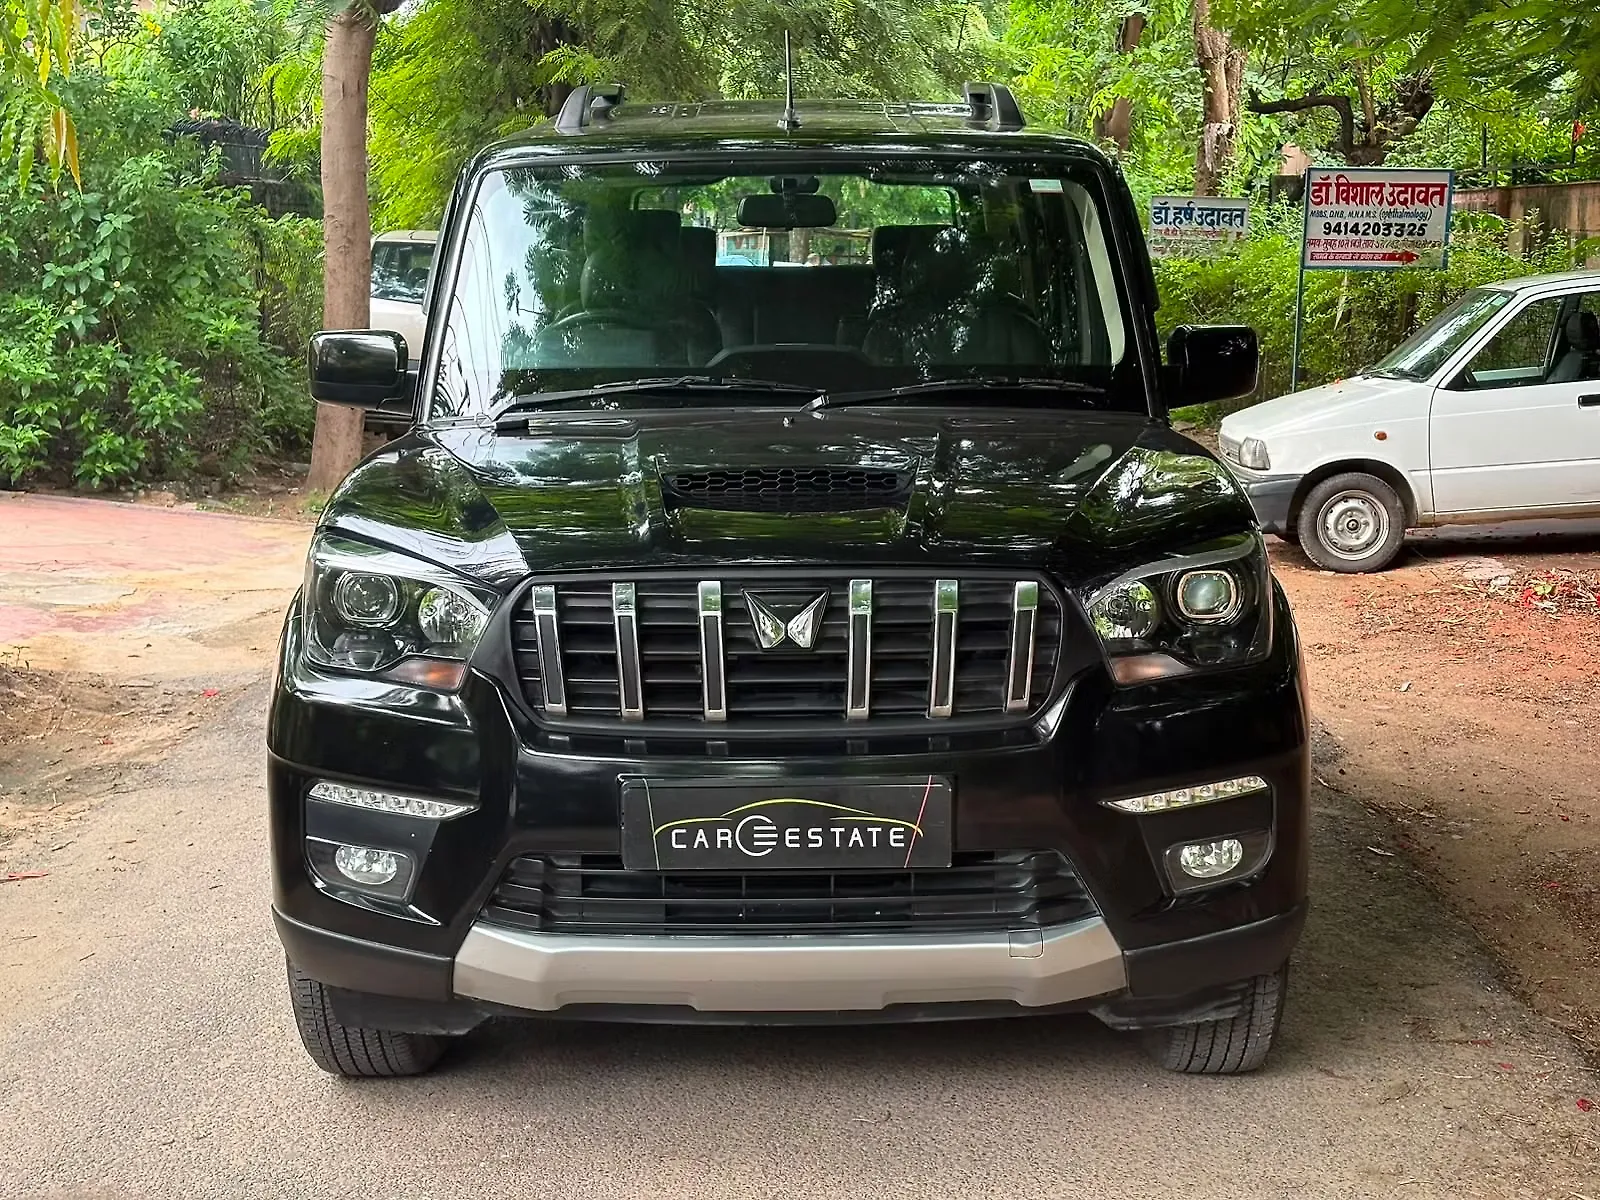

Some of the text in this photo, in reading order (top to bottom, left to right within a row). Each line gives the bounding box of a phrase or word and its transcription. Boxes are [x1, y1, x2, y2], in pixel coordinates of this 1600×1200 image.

[1385, 183, 1447, 209] उदावत
[1195, 207, 1246, 230] उदावत
[1323, 221, 1428, 237] 9414203325
[785, 827, 905, 848] ESTATE
